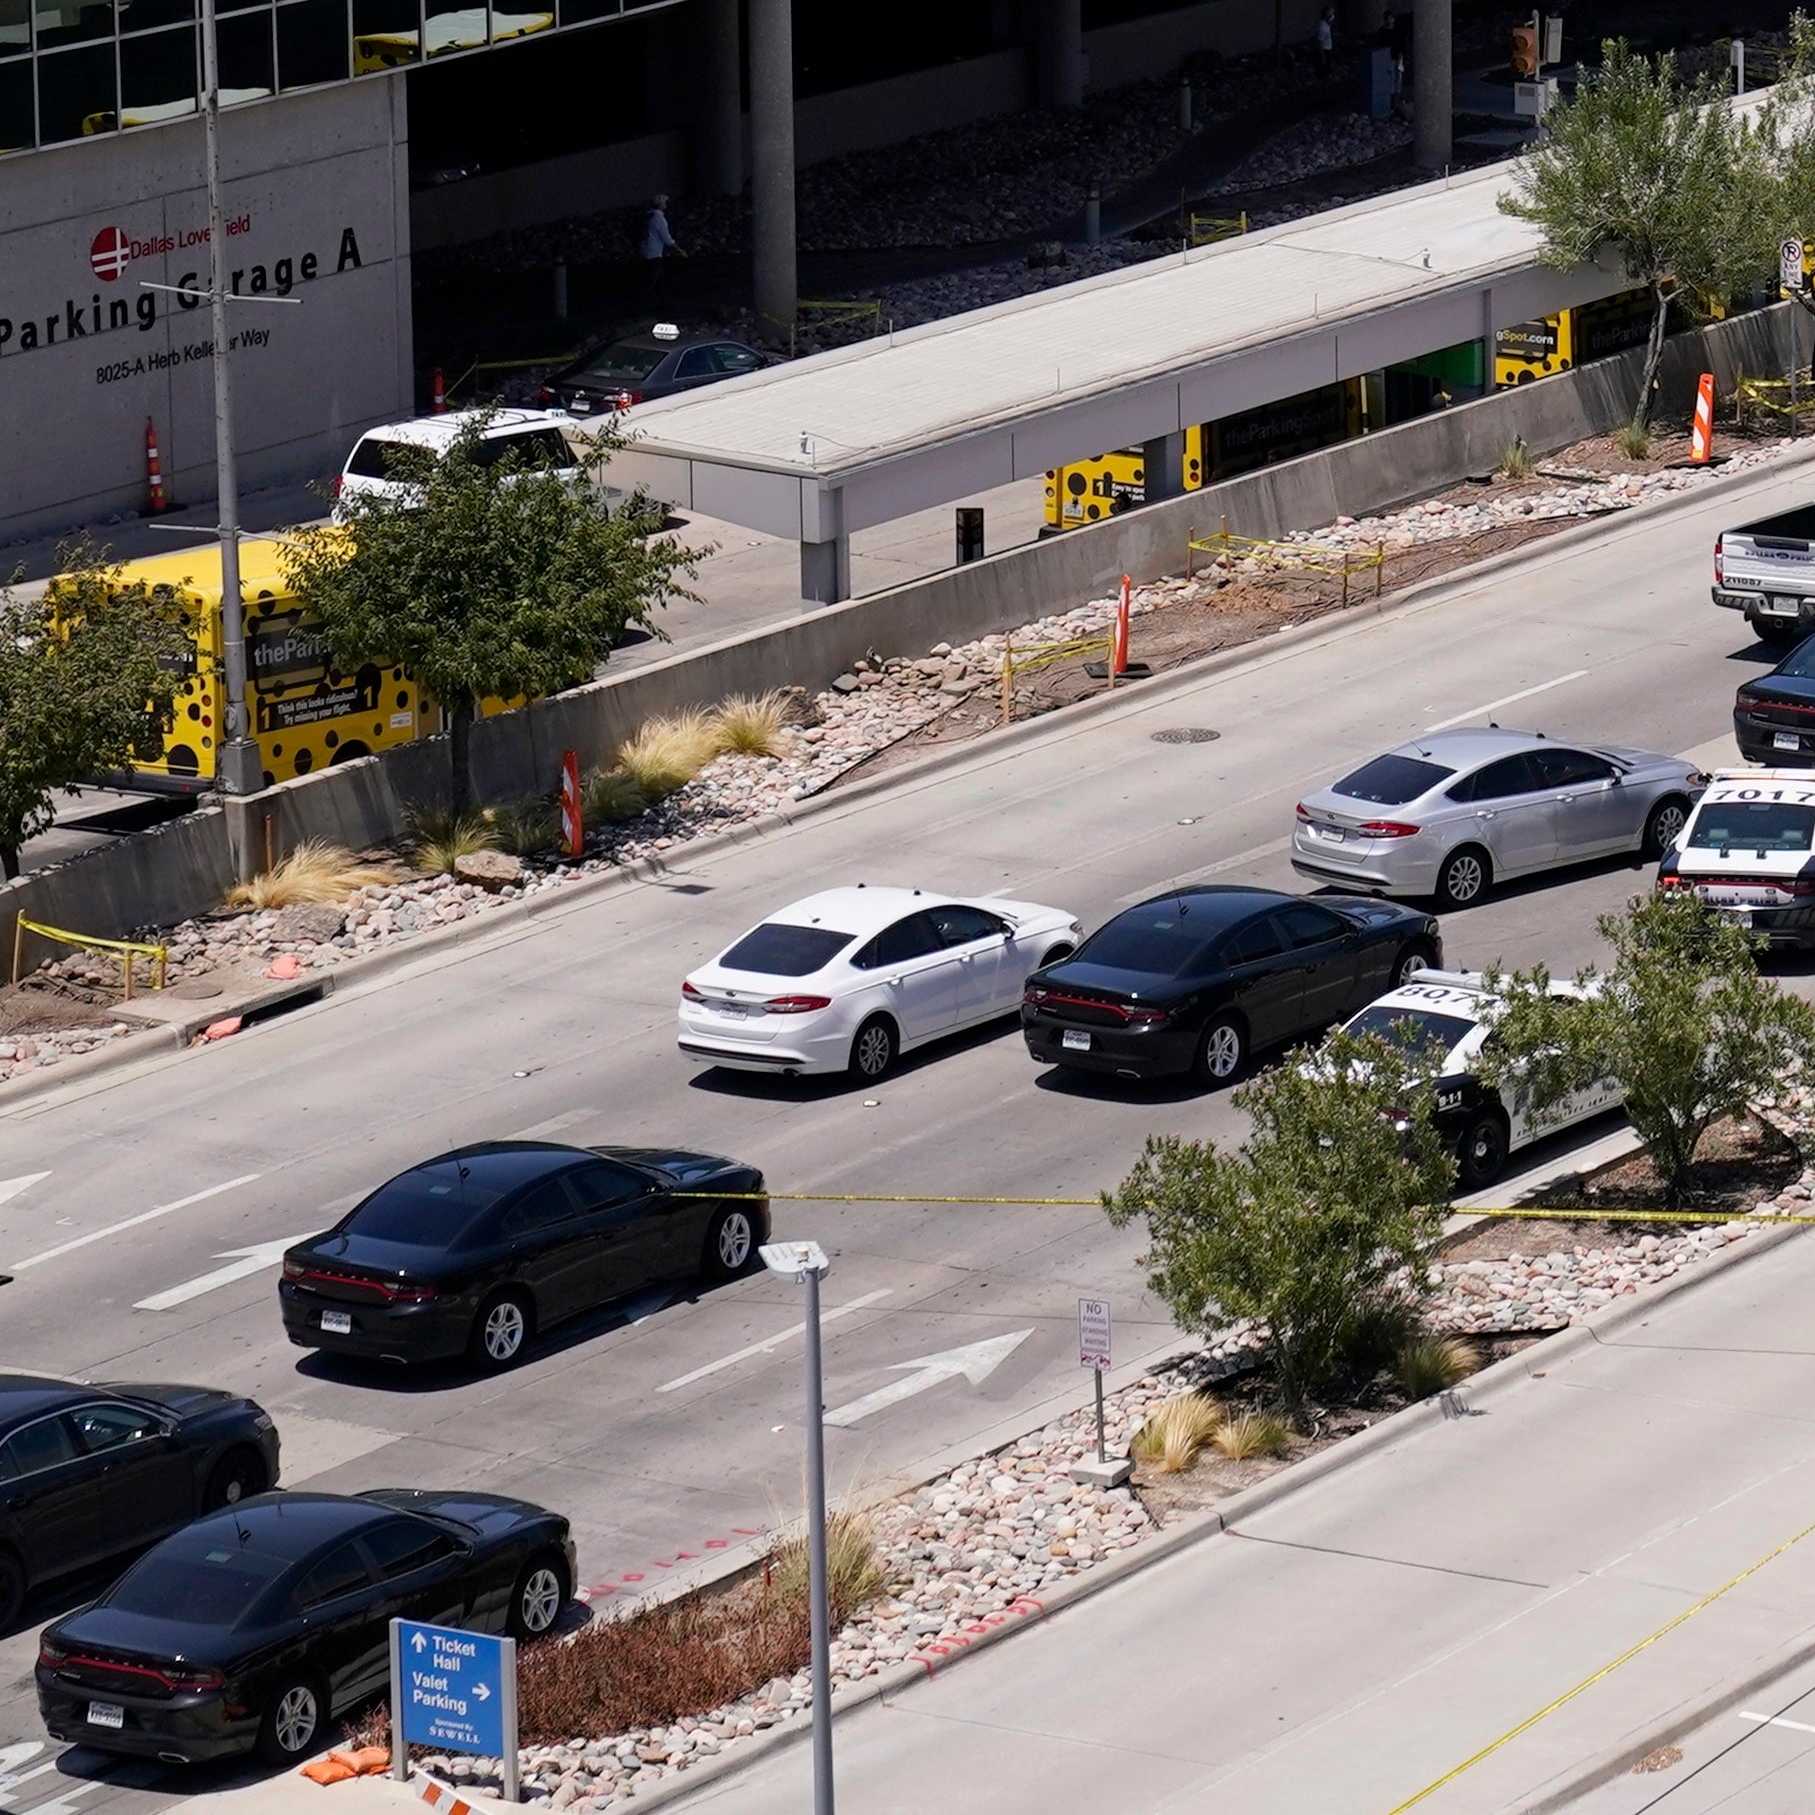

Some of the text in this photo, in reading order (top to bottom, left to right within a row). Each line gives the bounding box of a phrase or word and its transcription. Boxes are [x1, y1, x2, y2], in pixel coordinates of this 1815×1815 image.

[131, 233, 175, 262] Dallas
[179, 229, 213, 253] Love
[0, 227, 363, 352] Parking Grage A
[1495, 328, 1555, 345] gSpot.com
[96, 356, 146, 385] 8025-A
[148, 345, 180, 372] Herb
[241, 328, 270, 349] Way
[1083, 1316, 1107, 1325] PARKING
[1086, 1304, 1102, 1315] NO
[433, 1635, 477, 1658] Ticket
[433, 1653, 462, 1673] Hall
[412, 1671, 450, 1694] Valet
[413, 1689, 468, 1716] Parking
[428, 1726, 481, 1745] SEWELL
